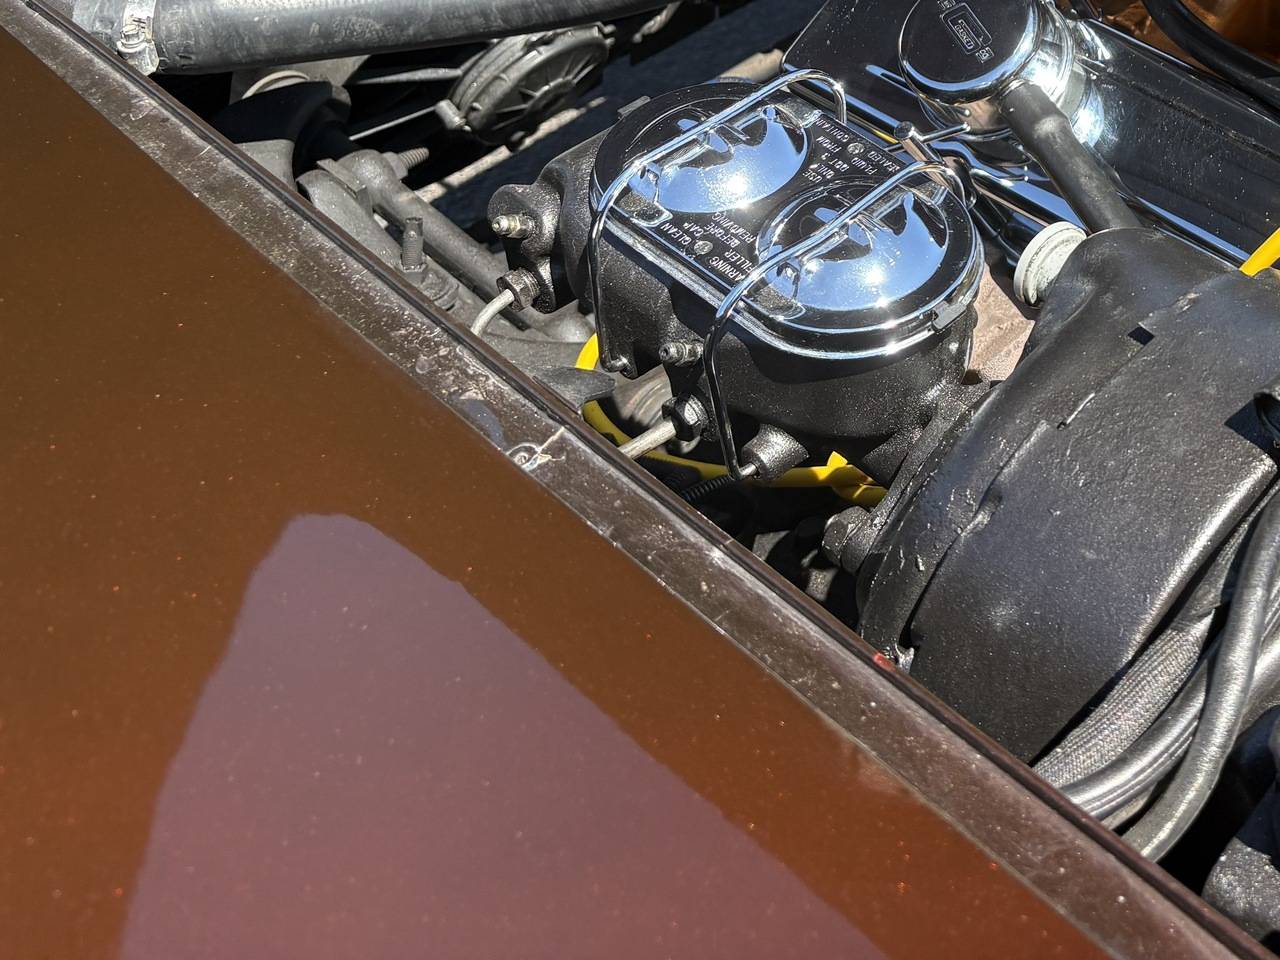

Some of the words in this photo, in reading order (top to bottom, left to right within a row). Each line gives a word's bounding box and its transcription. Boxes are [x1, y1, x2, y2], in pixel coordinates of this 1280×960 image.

[815, 135, 843, 153] FROM
[803, 168, 823, 183] USE
[850, 156, 878, 175] FLUID
[660, 222, 692, 246] CLEAN
[682, 221, 705, 237] CAP
[704, 221, 741, 248] BEFORE
[711, 210, 757, 244] REMOVING
[708, 255, 745, 281] ARNING
[724, 248, 756, 274] FILLER
